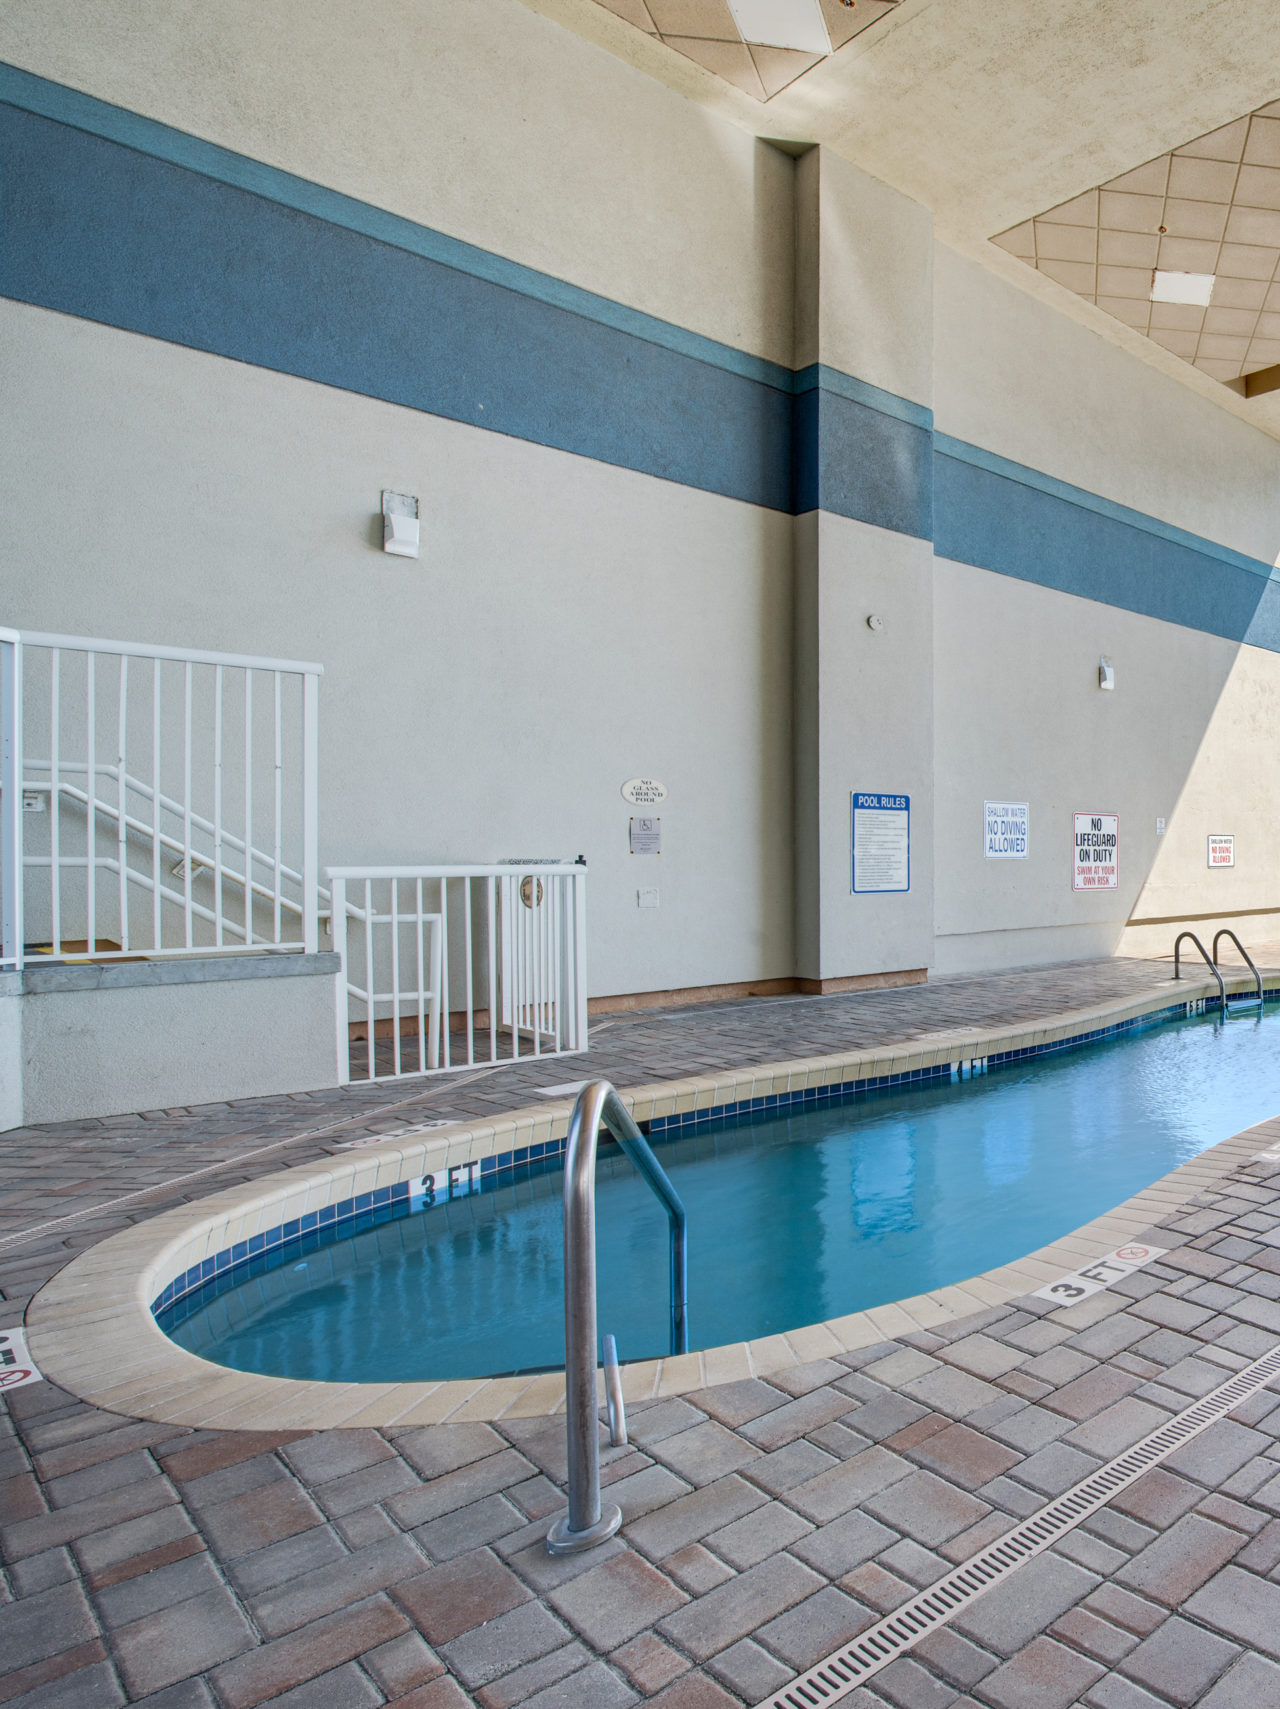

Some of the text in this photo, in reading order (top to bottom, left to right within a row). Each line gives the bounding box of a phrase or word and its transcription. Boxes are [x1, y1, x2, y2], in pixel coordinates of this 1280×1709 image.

[858, 795, 906, 808] POOL RULES
[987, 806, 1026, 818] SHALLOW WATER
[987, 820, 1026, 836] NO DIVING
[1091, 817, 1102, 832] NO
[988, 837, 1026, 853] ALLOWED
[1075, 833, 1117, 848] LIFEGUARD
[1079, 848, 1113, 863] ON DUTY
[1211, 845, 1232, 855] NO DIVING
[1212, 855, 1231, 864] ALLOWED
[1077, 865, 1115, 876] SWIM AT YOUR
[1083, 875, 1110, 886] OWN RISK
[420, 1160, 479, 1208] 3 FT
[1050, 1260, 1127, 1298] 3 FT
